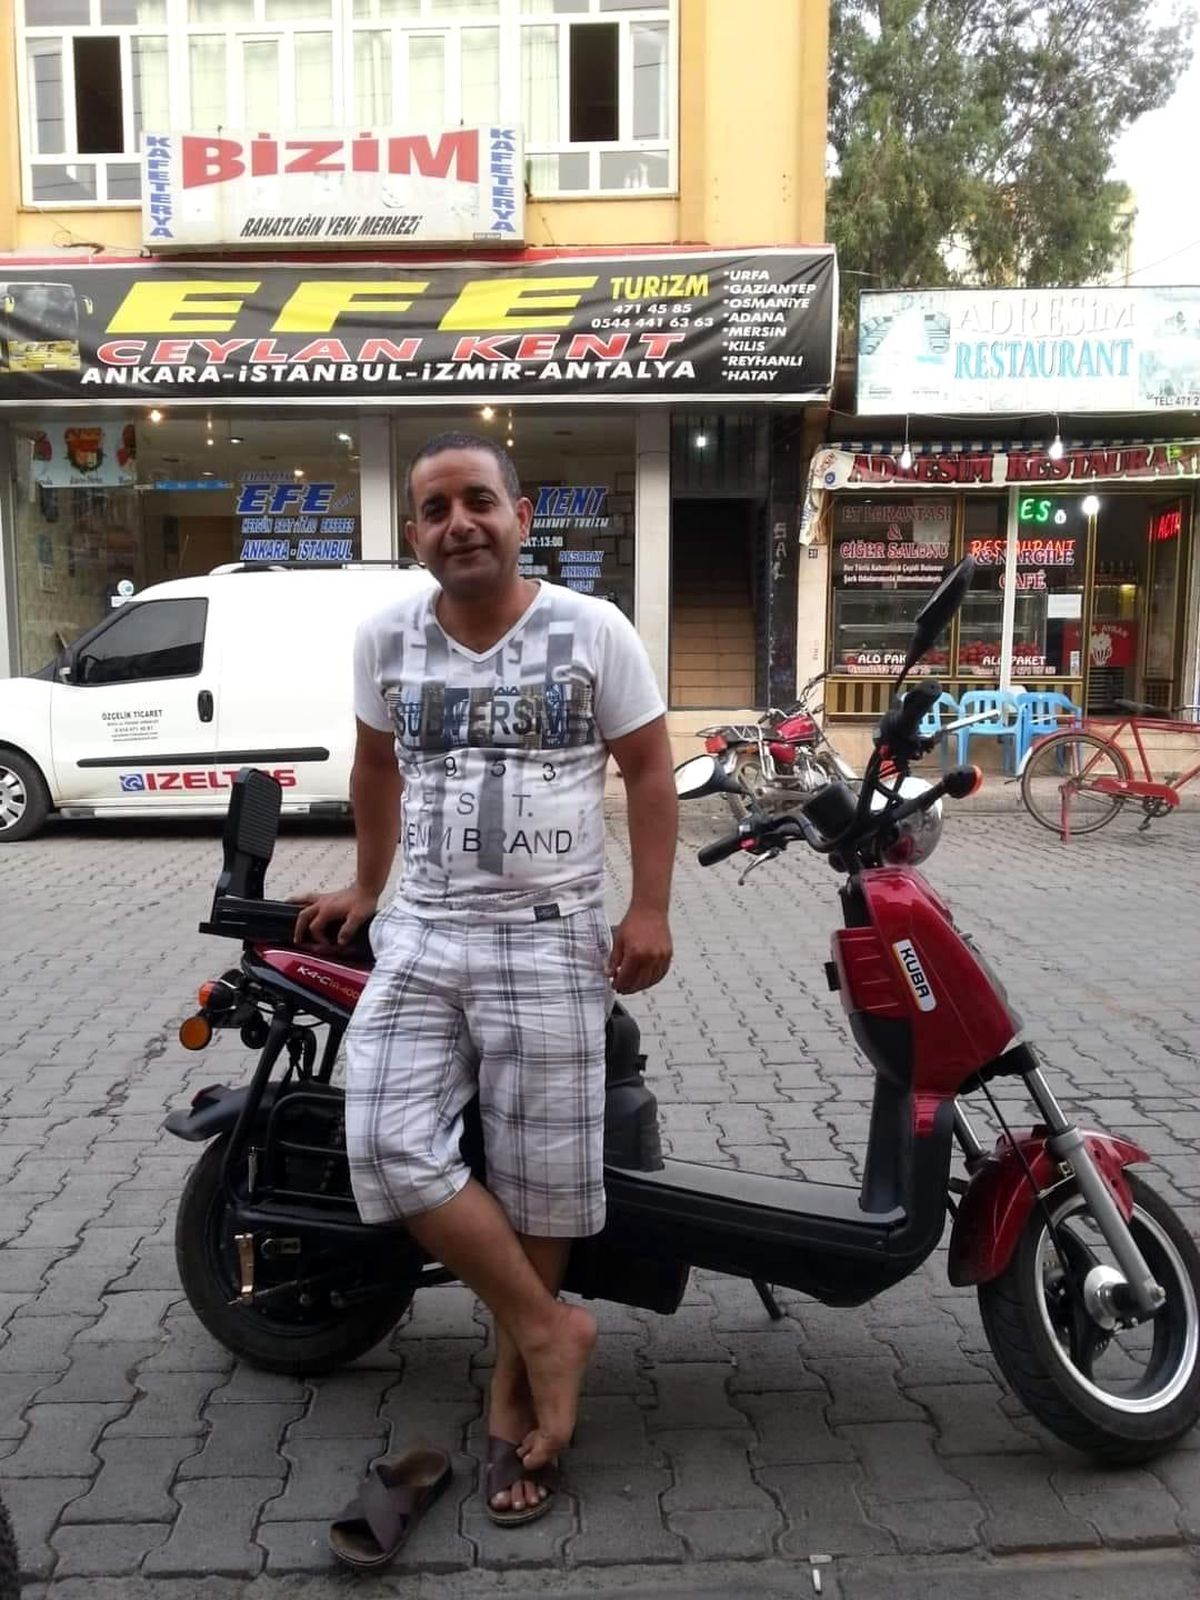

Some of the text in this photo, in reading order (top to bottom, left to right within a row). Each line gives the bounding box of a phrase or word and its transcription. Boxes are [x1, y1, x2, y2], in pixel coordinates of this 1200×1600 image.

[182, 129, 479, 190] BİZİM
[146, 136, 173, 237] KAFETERYA
[489, 128, 515, 232] KAFETERYA
[730, 269, 770, 281] URFA
[105, 276, 598, 333] EFE
[613, 303, 692, 314] 471 45 85
[728, 312, 785, 323] ADANA
[591, 316, 714, 329] 0544 441 63 63
[97, 333, 685, 364] CEYLAN KENT
[954, 338, 1134, 380] RESTAURANT
[728, 369, 778, 382] HATAY
[236, 482, 336, 514] EFE
[534, 486, 608, 516] KENT
[240, 539, 289, 560] ANKARA
[970, 540, 1076, 555] RESAURANT
[900, 947, 930, 997] KUBA
